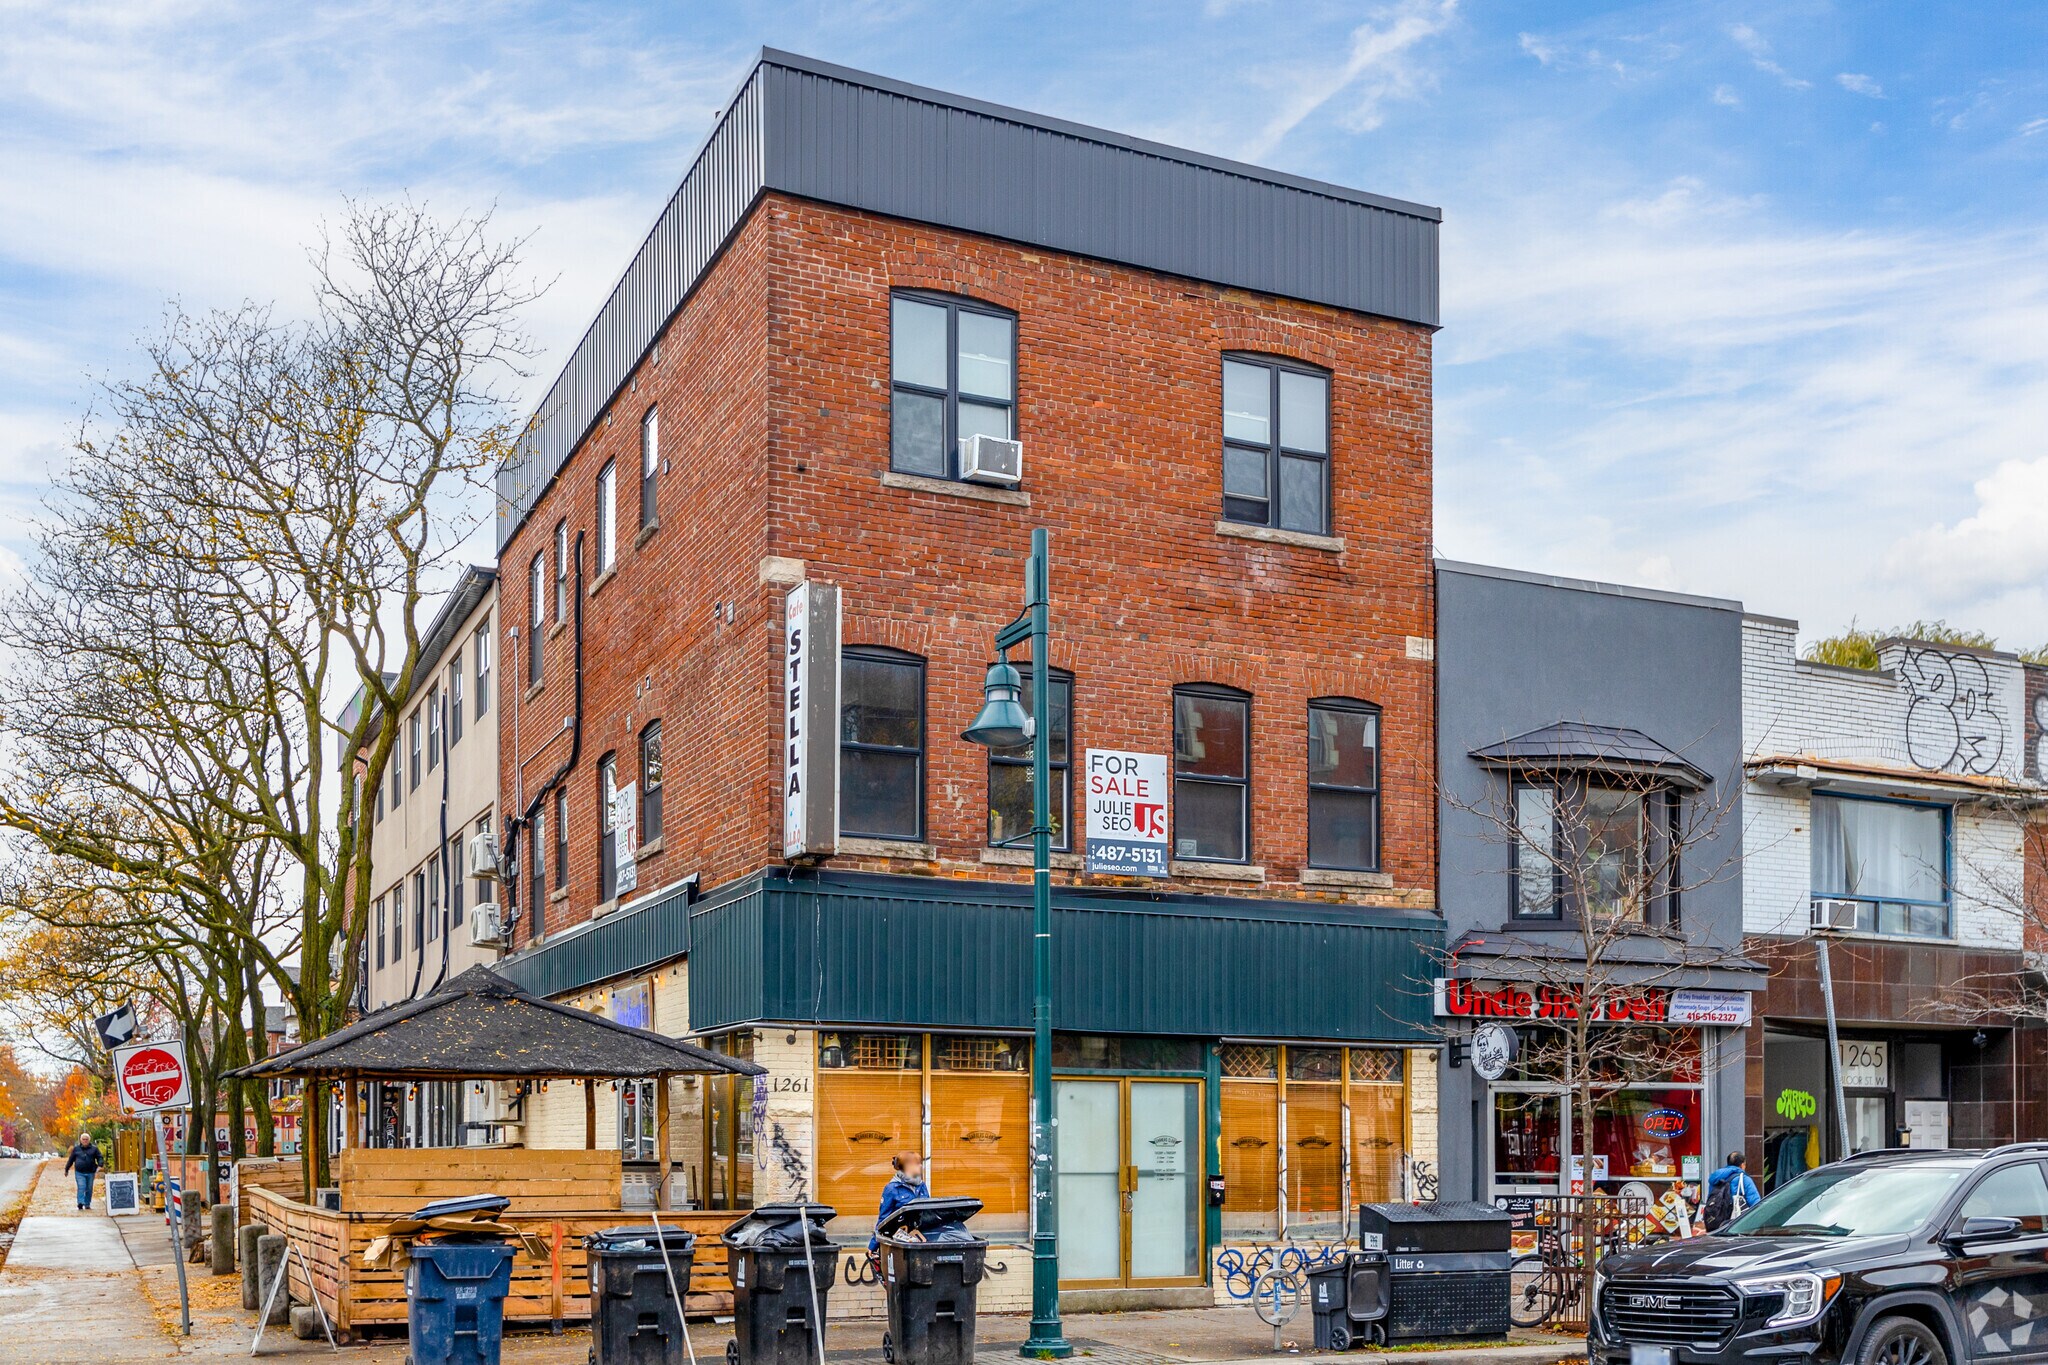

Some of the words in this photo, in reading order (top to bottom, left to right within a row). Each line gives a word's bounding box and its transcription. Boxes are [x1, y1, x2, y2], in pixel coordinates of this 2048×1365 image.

[789, 629, 801, 797] STELLA
[1091, 755, 1138, 776] FOR
[1091, 776, 1149, 797] SALE
[617, 791, 628, 811] FOR
[1094, 800, 1131, 815] JULIE
[617, 807, 631, 829] SALE
[1103, 816, 1131, 831] SEO
[1096, 845, 1162, 864] 487-5131
[1092, 862, 1137, 873] julieseo.com
[1448, 979, 1532, 1017] Uncle
[1606, 987, 1665, 1022] Deli
[1687, 1012, 1737, 1022] 416-516-2327
[1839, 1045, 1883, 1067] 1265
[773, 1078, 808, 1092] 1261
[1876, 1077, 1885, 1086] W
[1643, 1117, 1684, 1130] OPEN
[1395, 1259, 1414, 1269] Litter
[1630, 1295, 1681, 1309] GMC
